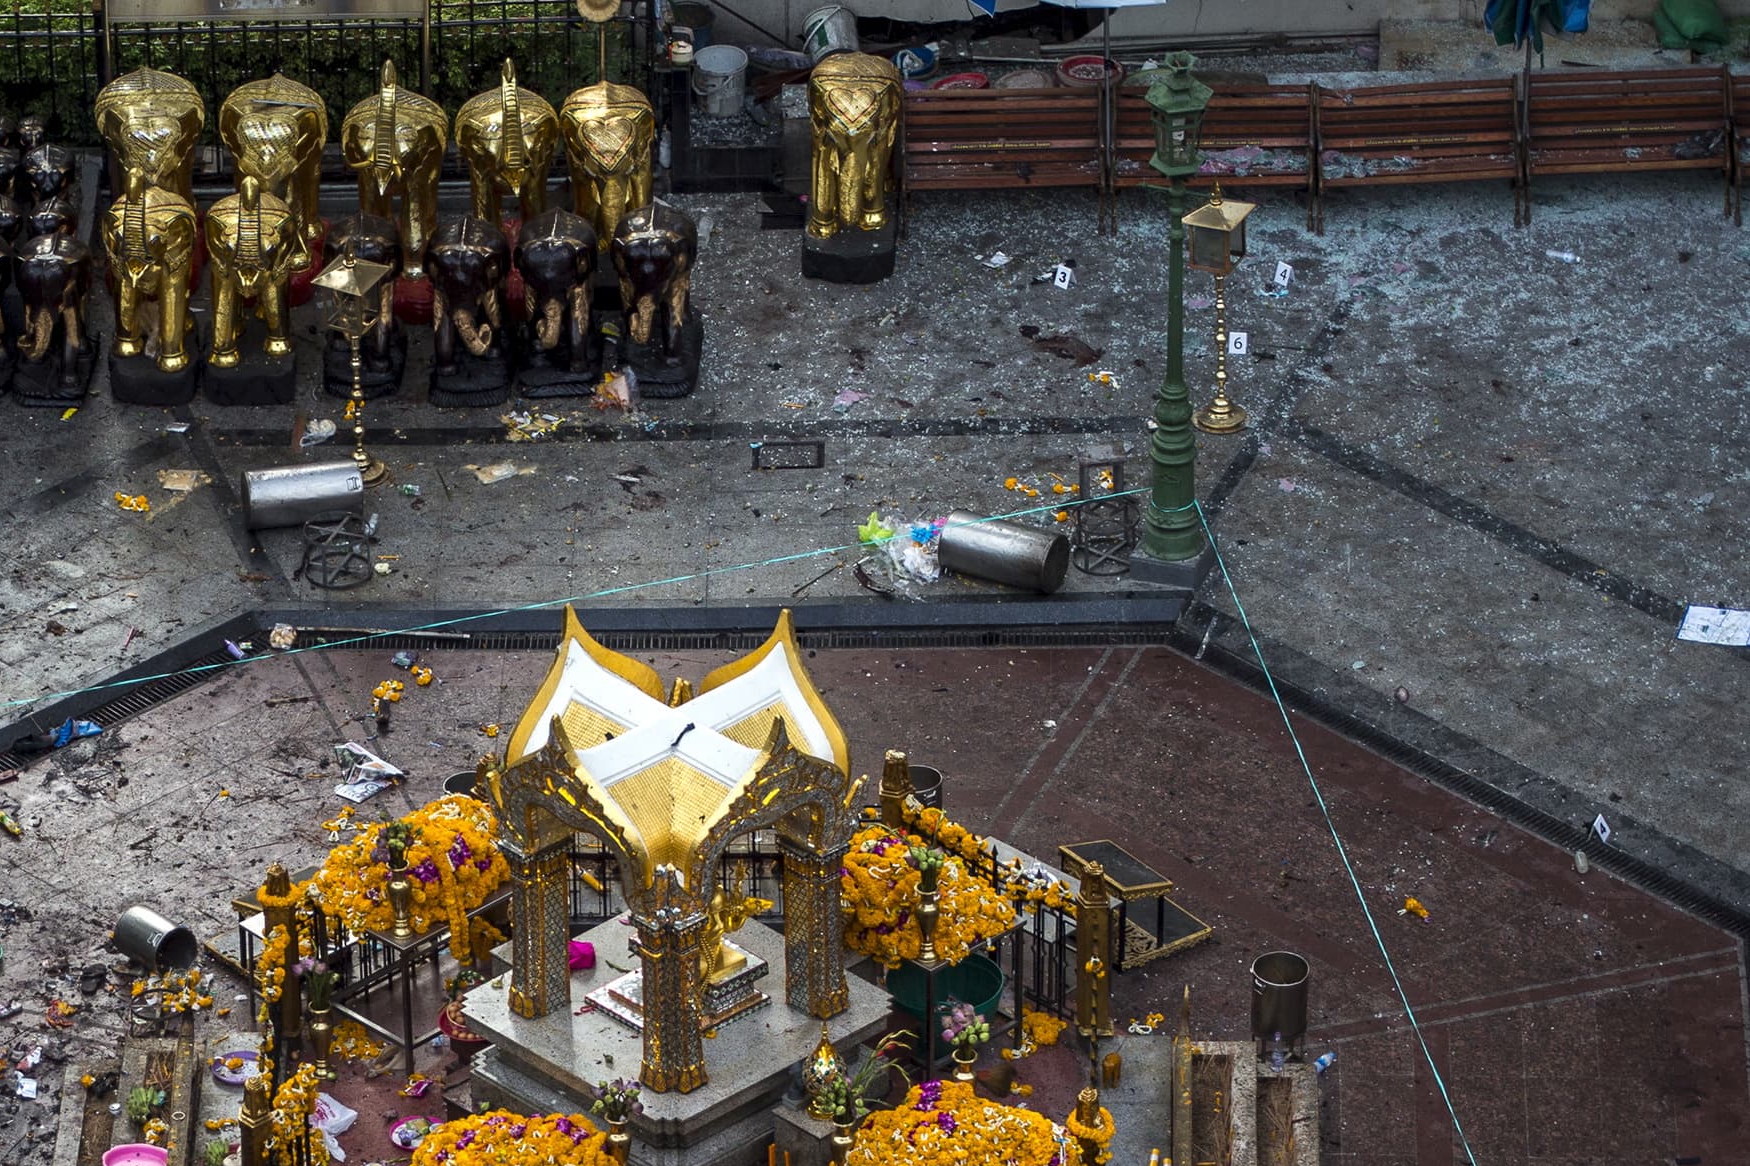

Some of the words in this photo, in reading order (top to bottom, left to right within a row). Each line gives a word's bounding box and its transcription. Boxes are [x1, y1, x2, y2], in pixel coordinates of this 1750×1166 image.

[1058, 271, 1067, 284] 3
[1280, 267, 1288, 281] 4
[1233, 337, 1243, 350] 6
[1600, 822, 1607, 834] 4
